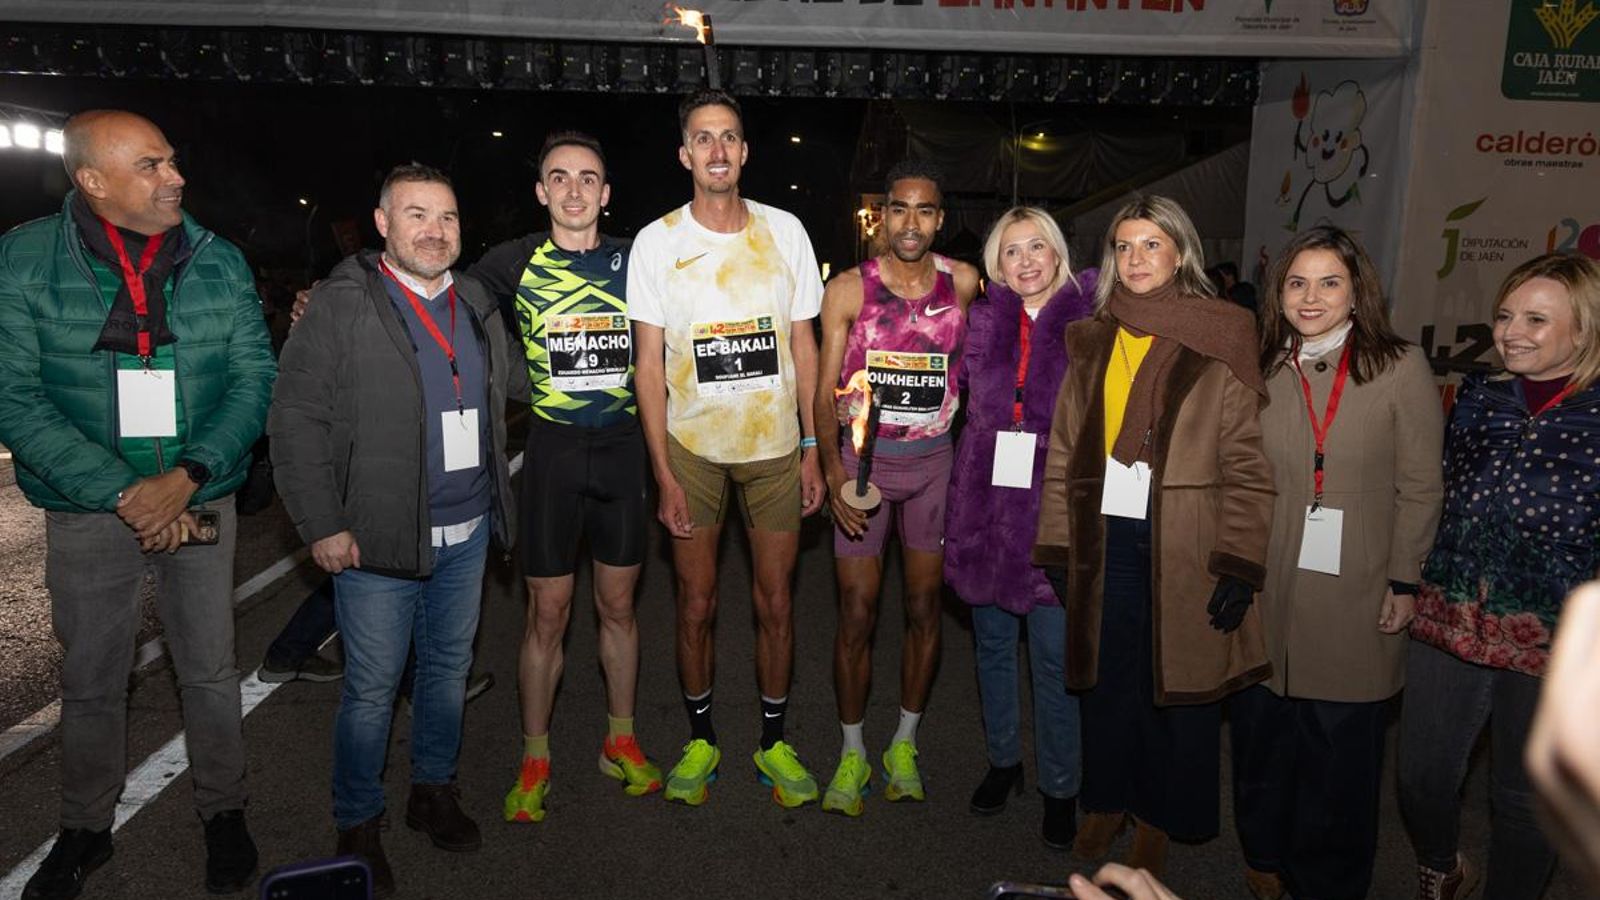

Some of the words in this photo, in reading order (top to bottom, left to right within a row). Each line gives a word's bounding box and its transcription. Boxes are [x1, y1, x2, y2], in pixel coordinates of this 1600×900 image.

[1512, 52, 1549, 68] CAJA
[1475, 130, 1600, 156] calderó
[1504, 157, 1533, 168] obras
[1535, 158, 1583, 169] maestras
[1461, 237, 1529, 249] DIPUTACIÓN
[1460, 251, 1477, 262] DE
[549, 335, 629, 352] MENACHO
[696, 344, 717, 357] EL
[720, 336, 775, 355] BAKALI
[588, 353, 599, 367] 9
[734, 357, 742, 371] 1
[868, 371, 944, 387] OUKHELFEN
[900, 391, 911, 404] 2
